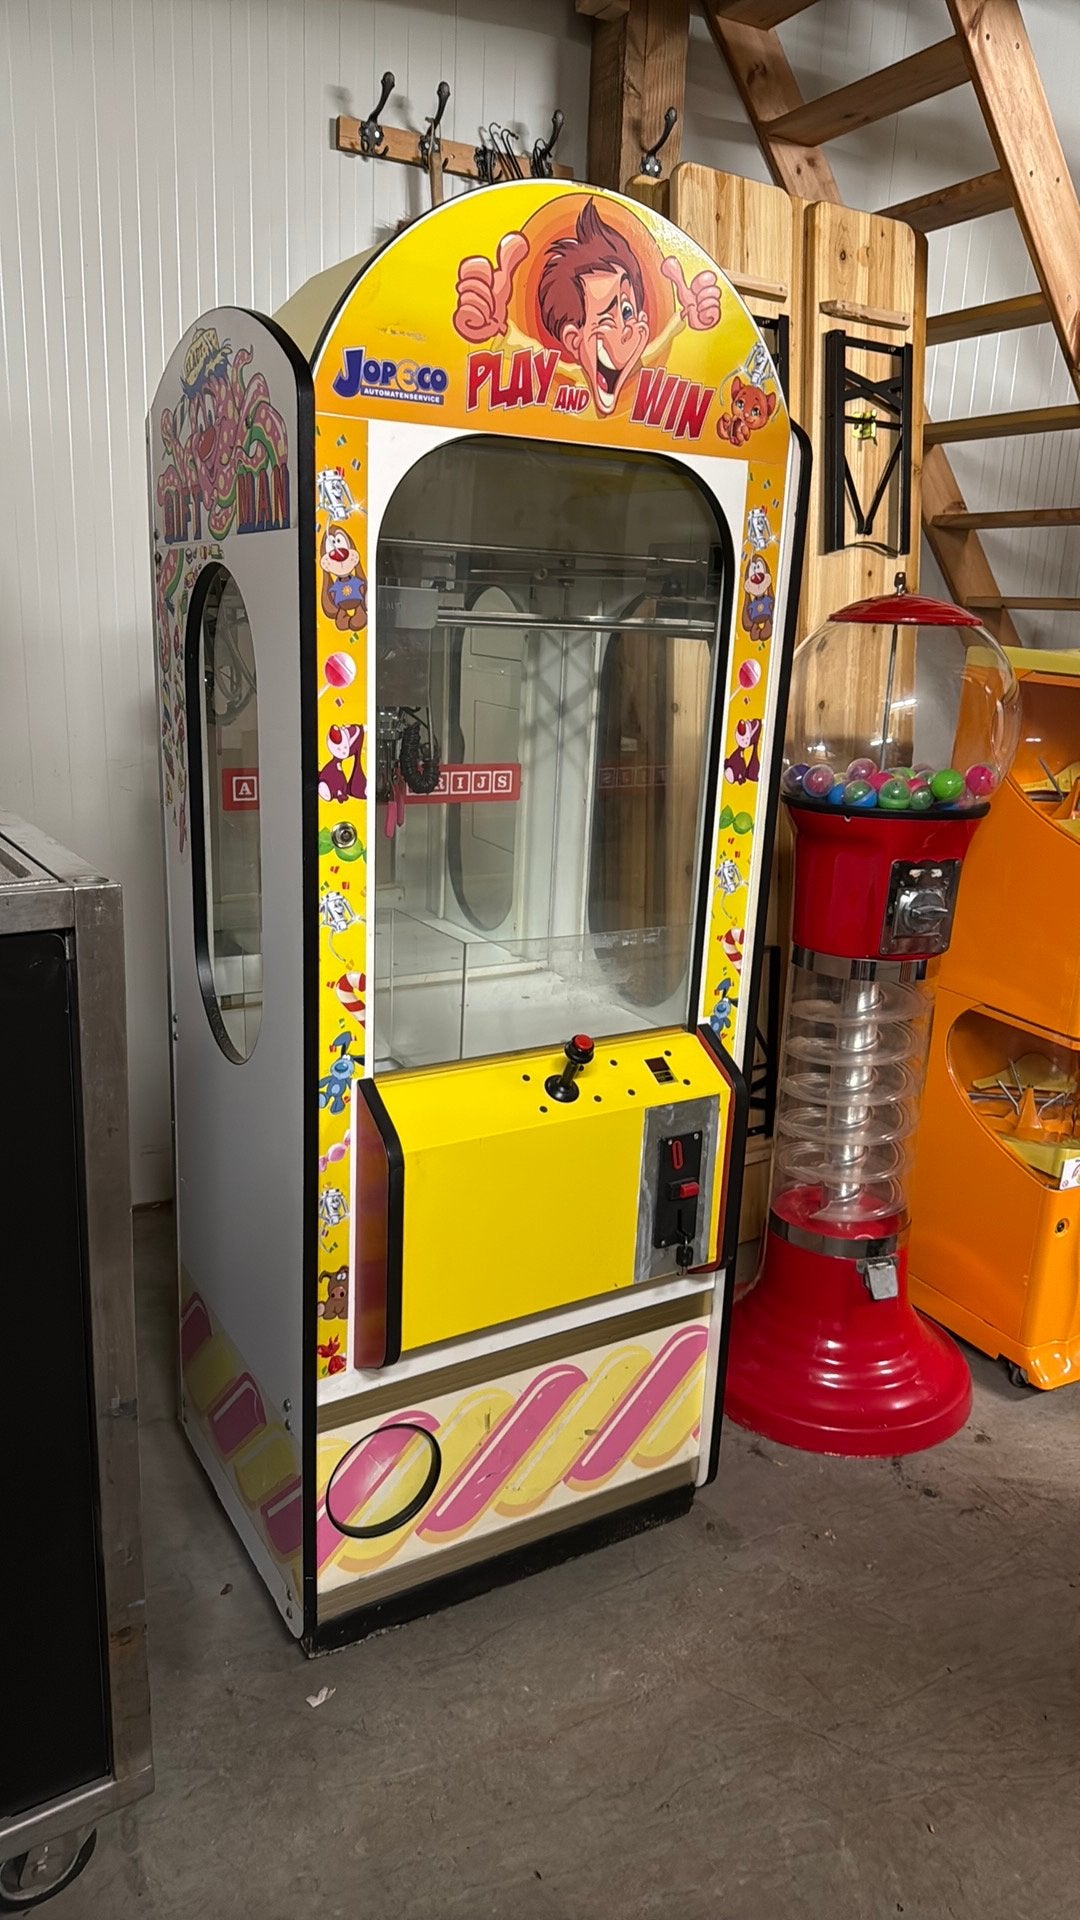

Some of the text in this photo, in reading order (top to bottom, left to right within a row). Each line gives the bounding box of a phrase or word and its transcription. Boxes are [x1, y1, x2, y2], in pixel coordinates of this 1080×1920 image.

[363, 387, 441, 403] AUTOMATENSERVICE
[466, 347, 716, 440] PLAY AND WIN
[236, 462, 291, 534] MAN
[238, 782, 252, 795] A
